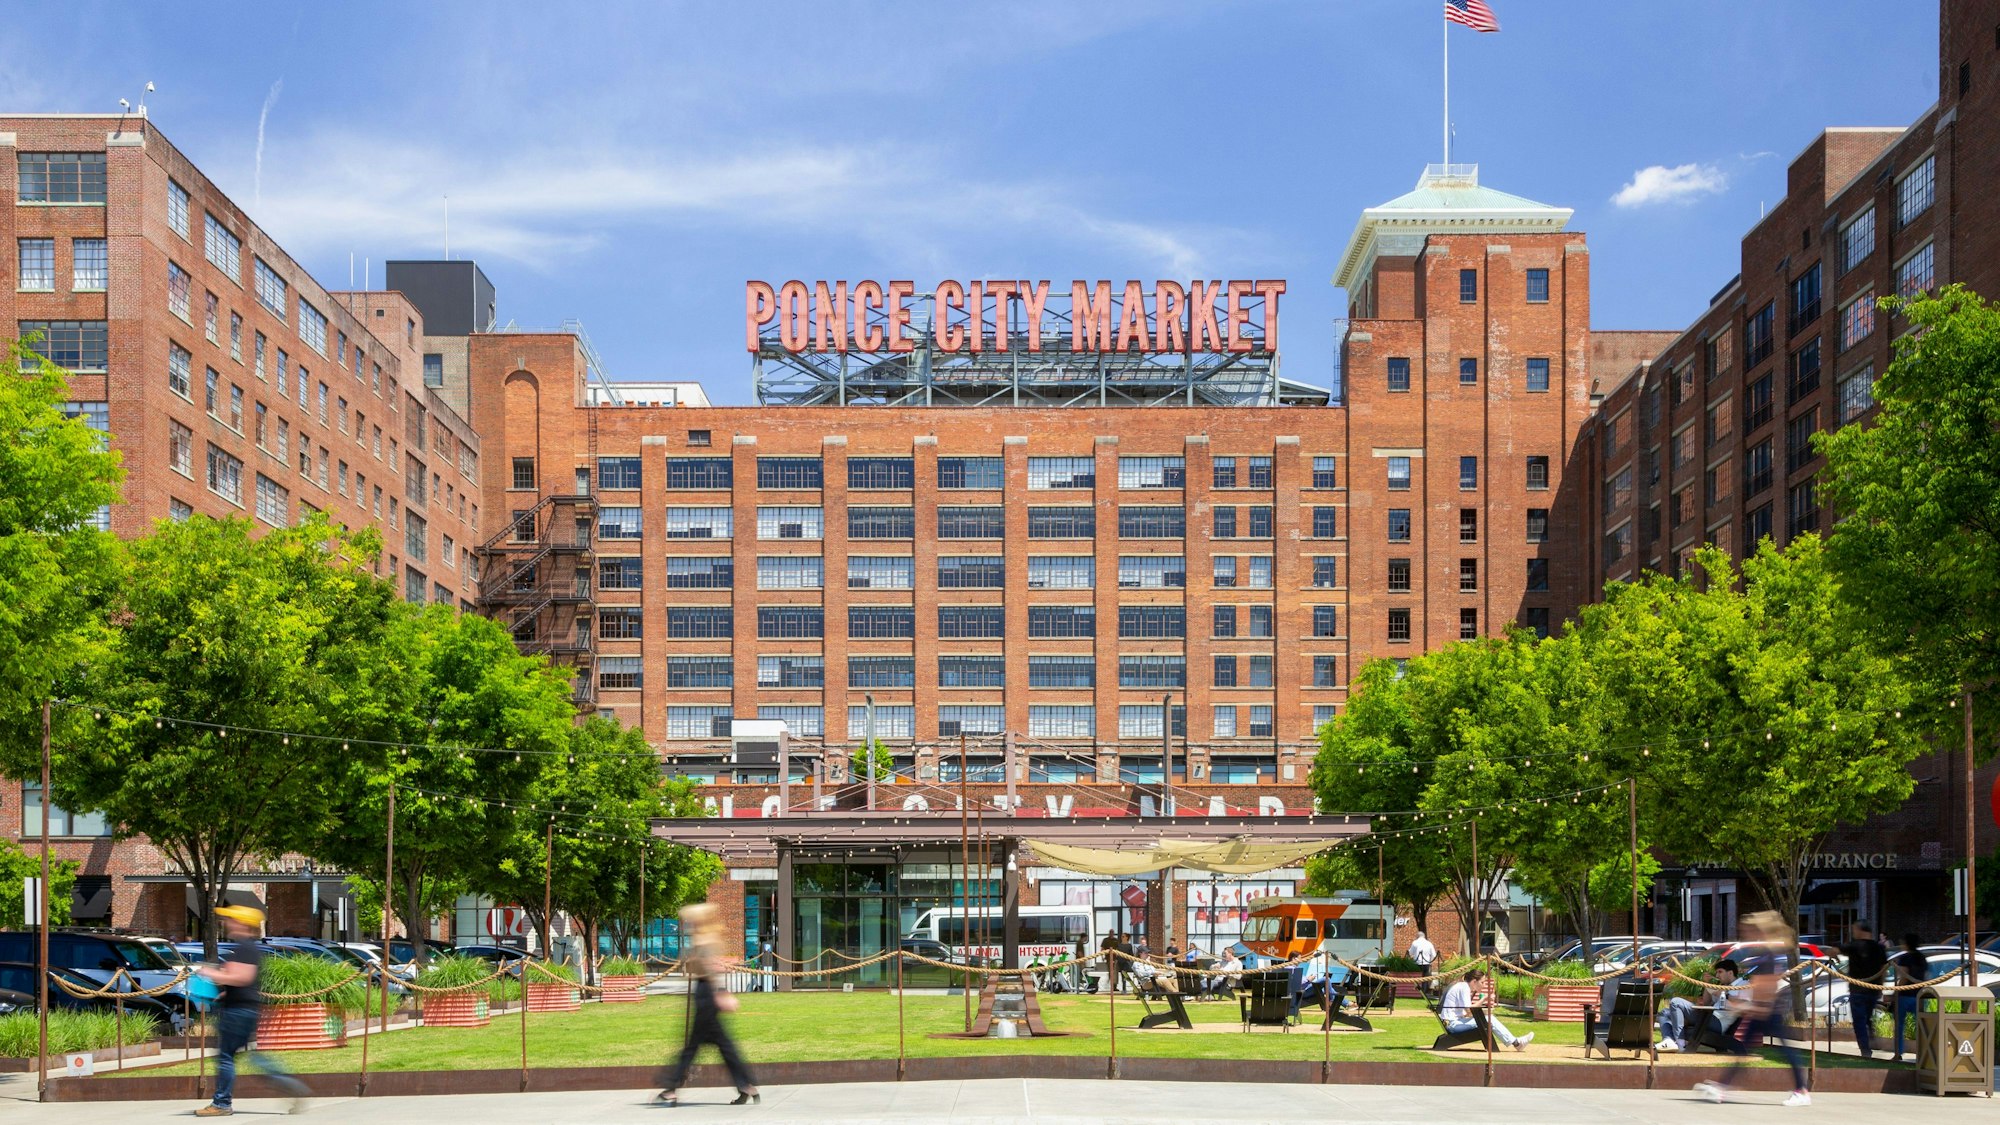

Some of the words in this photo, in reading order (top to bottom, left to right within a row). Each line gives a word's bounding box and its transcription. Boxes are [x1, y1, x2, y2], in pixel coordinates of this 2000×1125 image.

[746, 279, 914, 353] PONCE
[935, 279, 1051, 353] CITY
[1072, 279, 1287, 353] MARKET
[1780, 853, 1897, 869] NTRANCE
[958, 947, 1000, 957] ALANTA
[1019, 946, 1067, 956] HTSEEING
